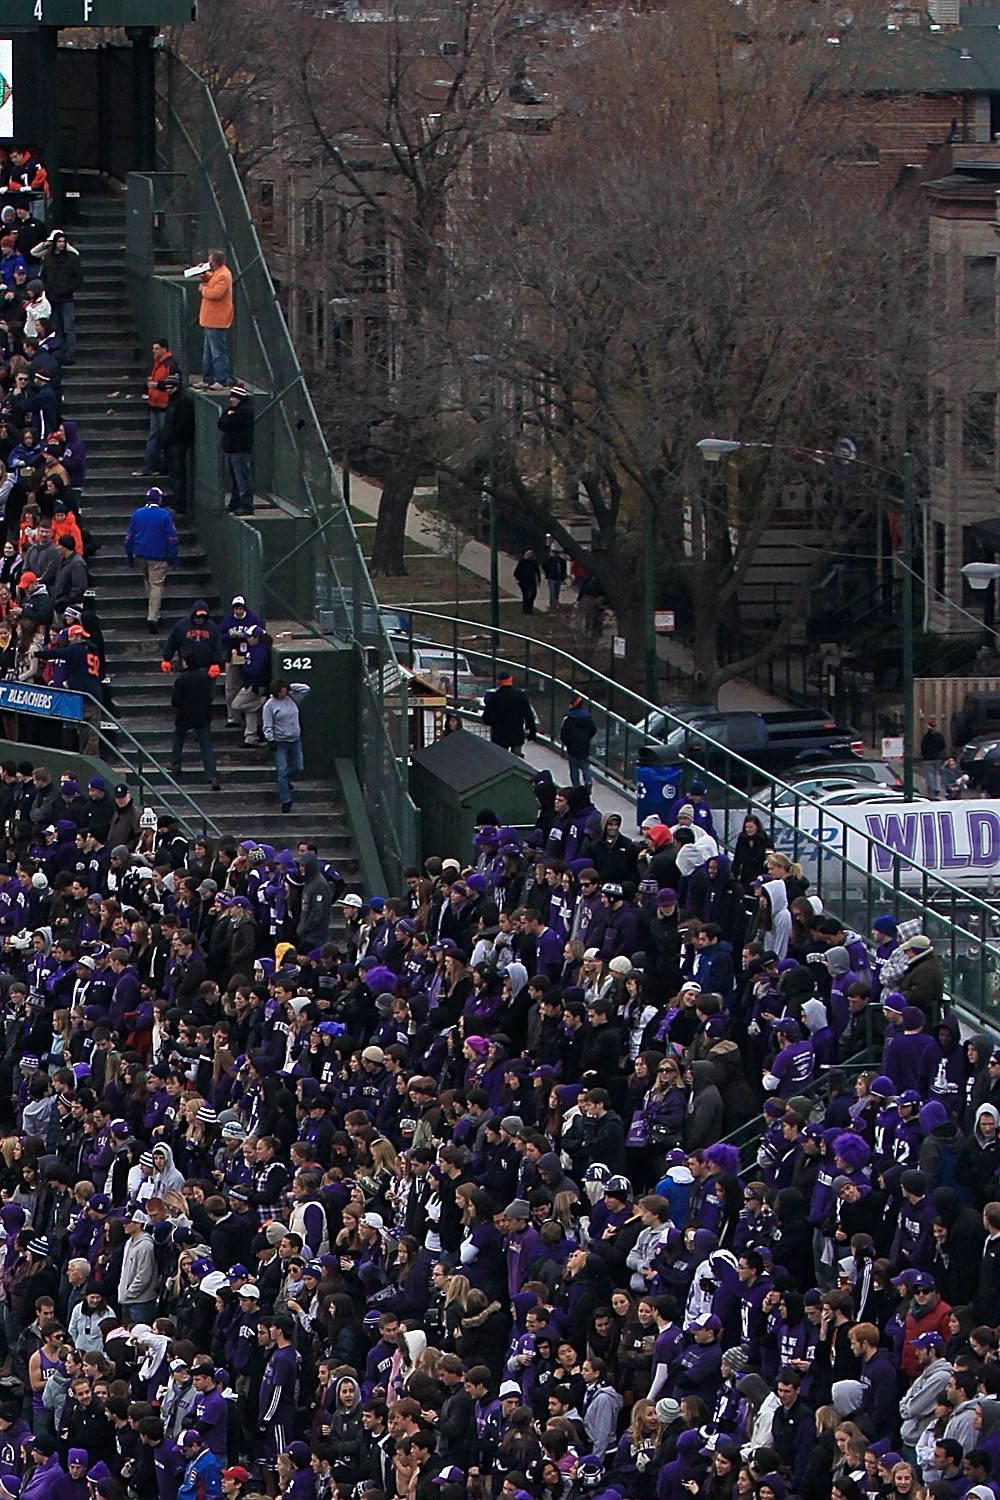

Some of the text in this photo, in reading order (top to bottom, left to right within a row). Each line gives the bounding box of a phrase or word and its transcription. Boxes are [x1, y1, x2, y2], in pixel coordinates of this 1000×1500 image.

[34, 0, 43, 21] 4
[84, 0, 93, 22] F
[283, 657, 312, 670] 342
[8, 688, 53, 710] BLEACHERS
[865, 810, 1000, 873] WILD
[593, 1169, 603, 1180] N
[619, 1178, 628, 1191] N
